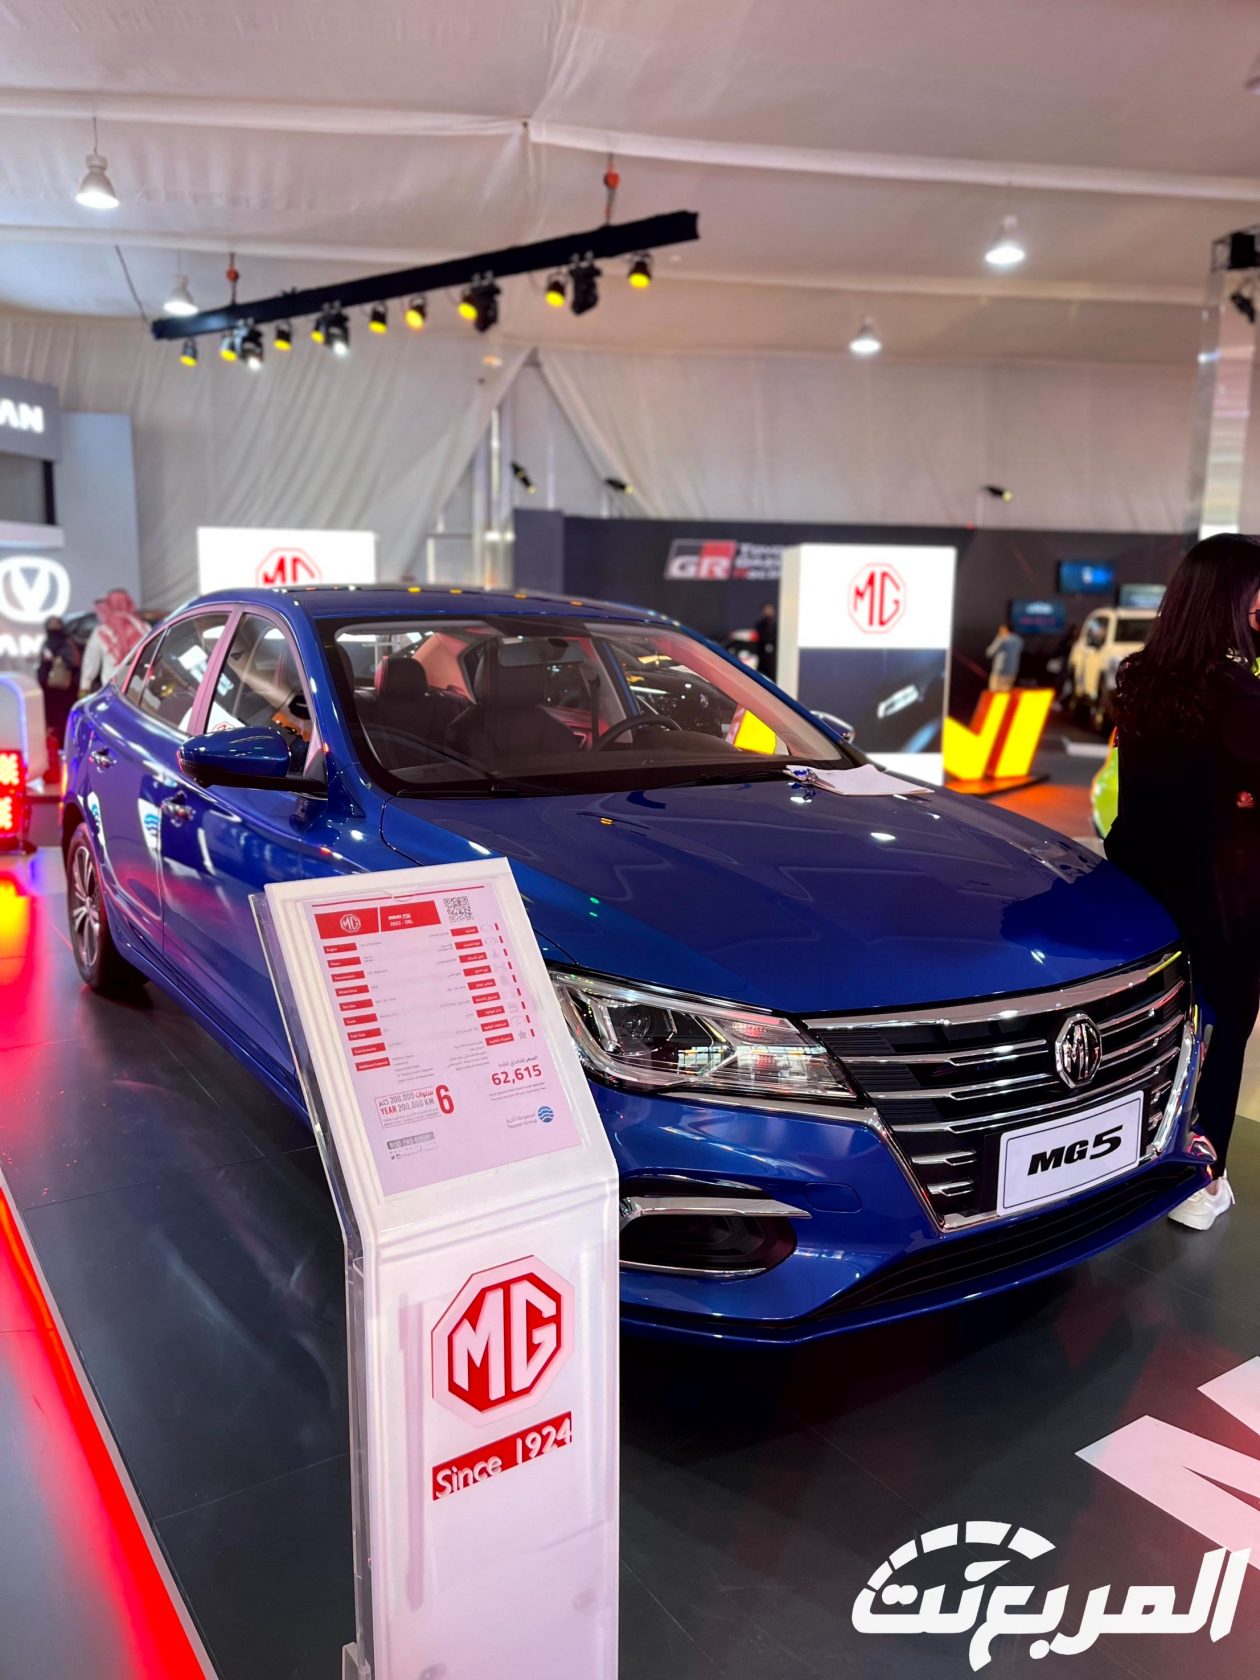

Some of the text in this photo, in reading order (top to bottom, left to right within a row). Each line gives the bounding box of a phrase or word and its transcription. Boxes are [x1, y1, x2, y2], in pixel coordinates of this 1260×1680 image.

[853, 569, 902, 627] MG
[342, 916, 360, 932] MG
[491, 1064, 542, 1086] 62,615
[380, 1097, 435, 1116] YEAR 200,000 KM
[435, 1084, 455, 1115] 6
[1026, 1125, 1124, 1176] MG5
[451, 1279, 558, 1401] MG
[434, 1417, 572, 1499] Since 1924
